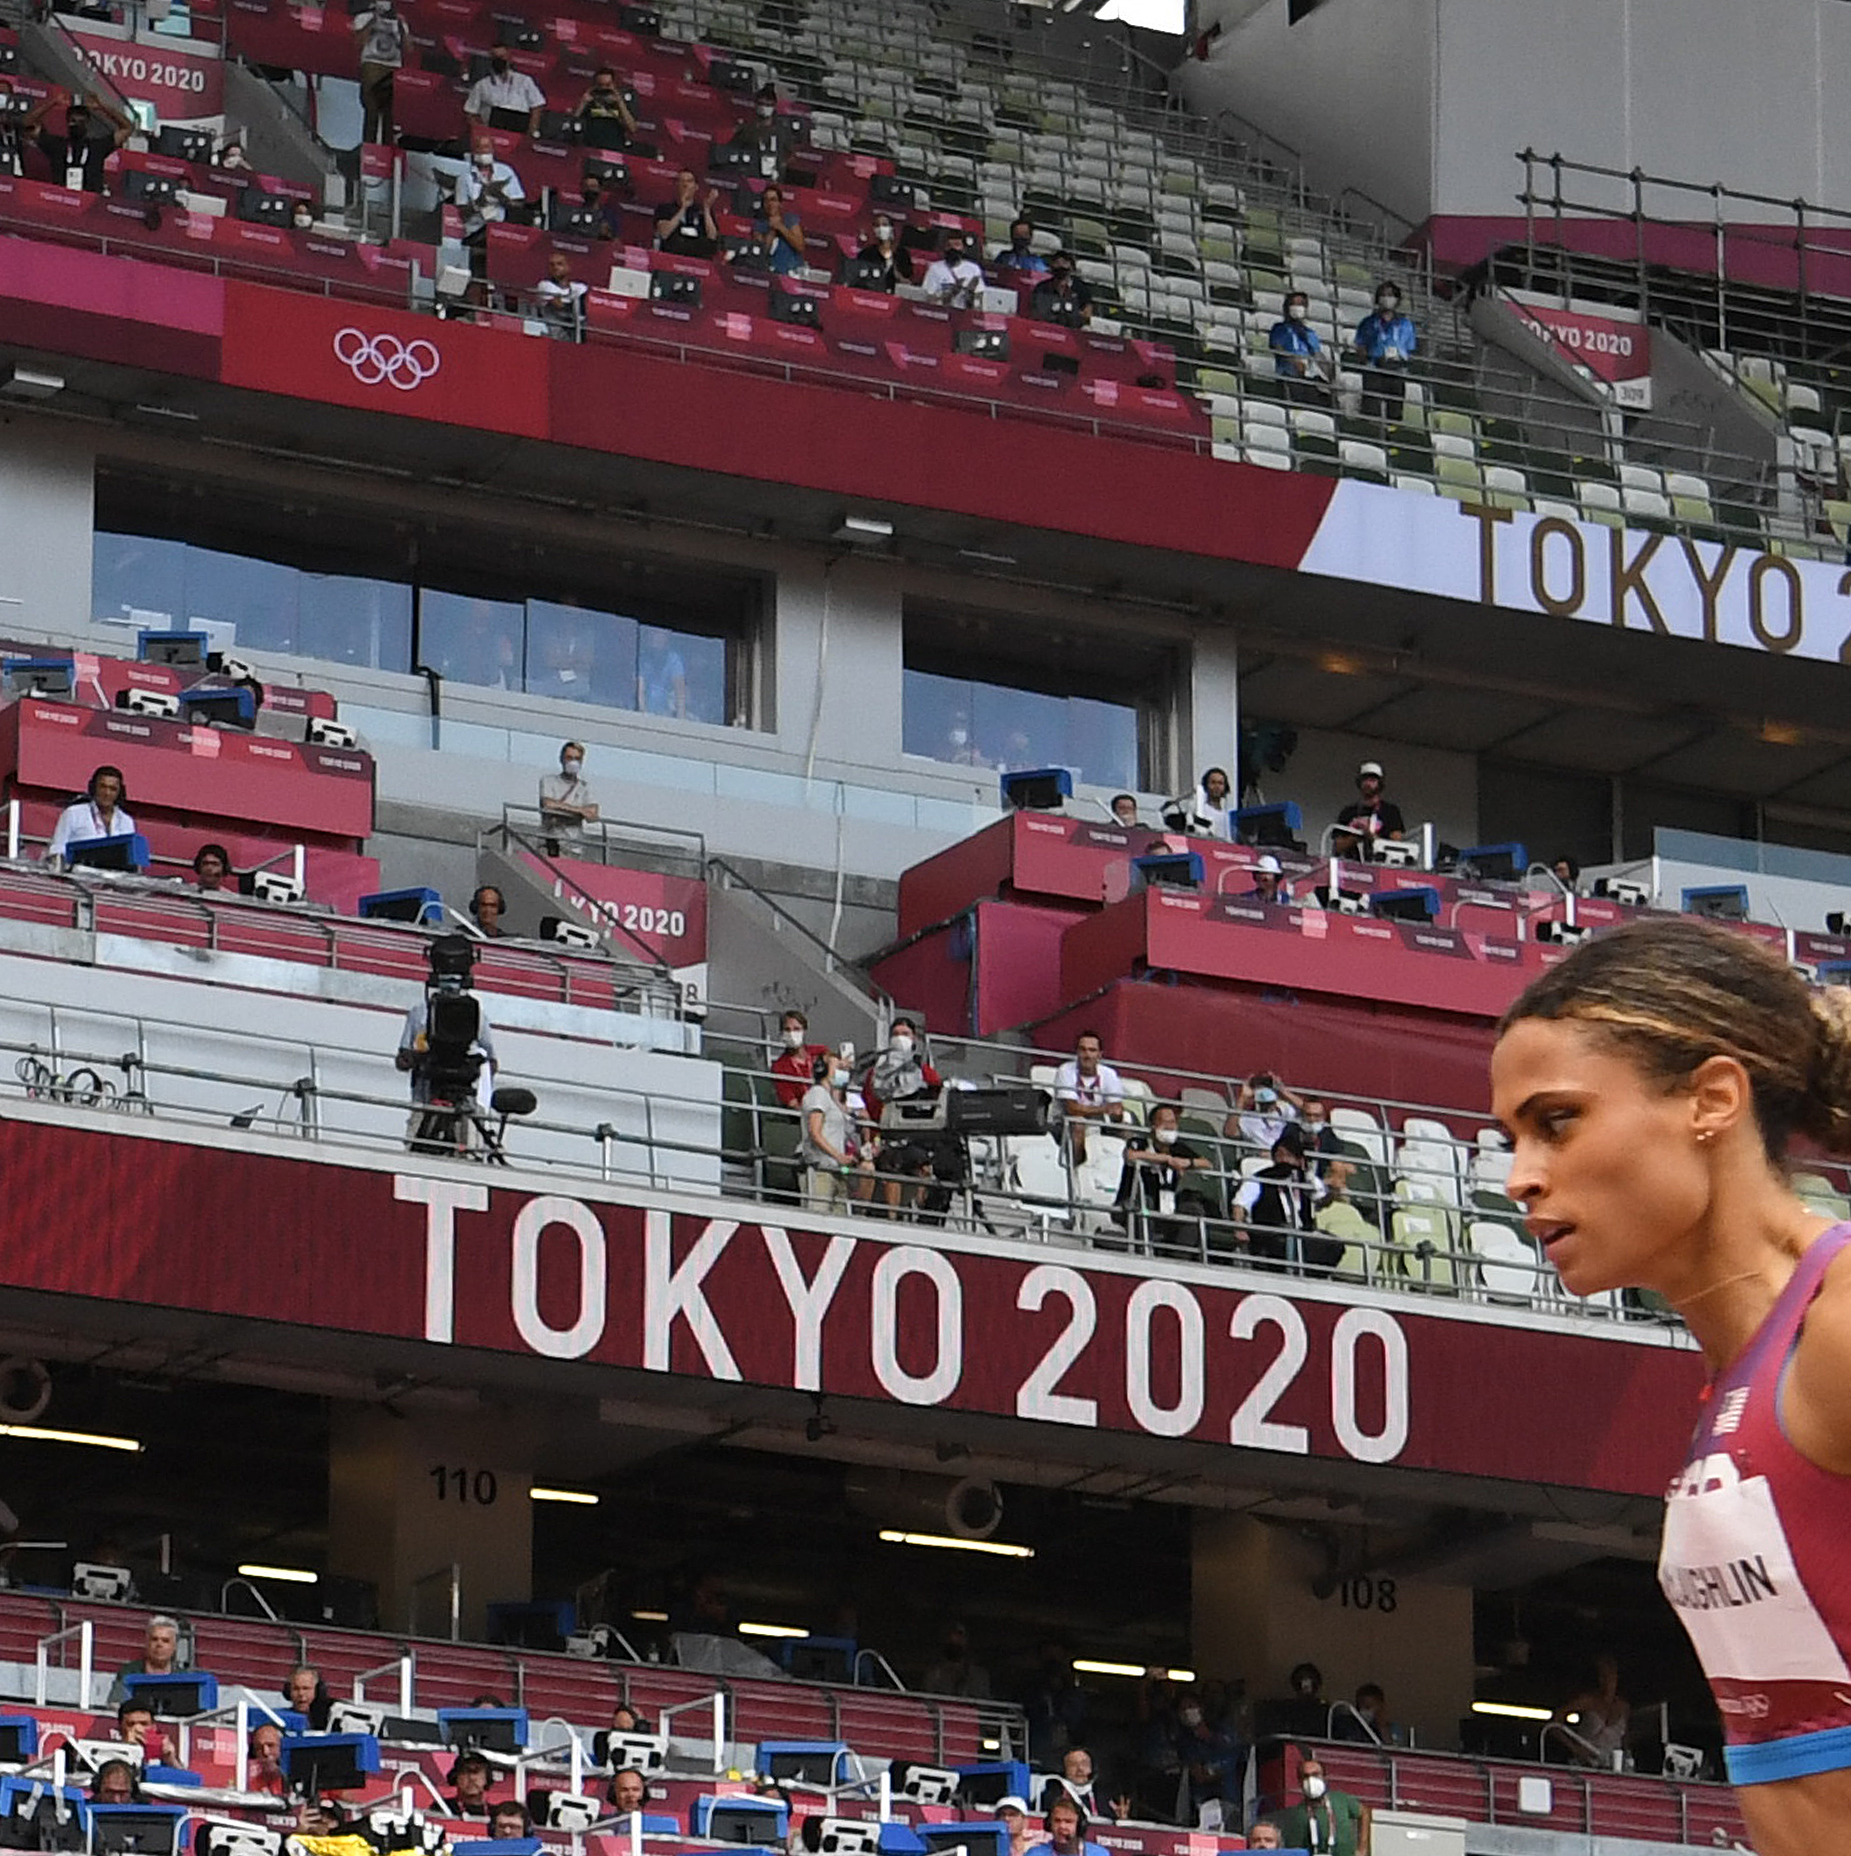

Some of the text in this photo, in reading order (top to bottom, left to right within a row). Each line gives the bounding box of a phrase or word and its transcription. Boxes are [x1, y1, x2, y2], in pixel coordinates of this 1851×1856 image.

[151, 64, 204, 93] 2020
[1459, 501, 1801, 655] TOKYO
[623, 905, 685, 937] 2020
[394, 1177, 1408, 1464] TOKYO 2020
[430, 1465, 497, 1506] 110
[1340, 1578, 1396, 1612] 108
